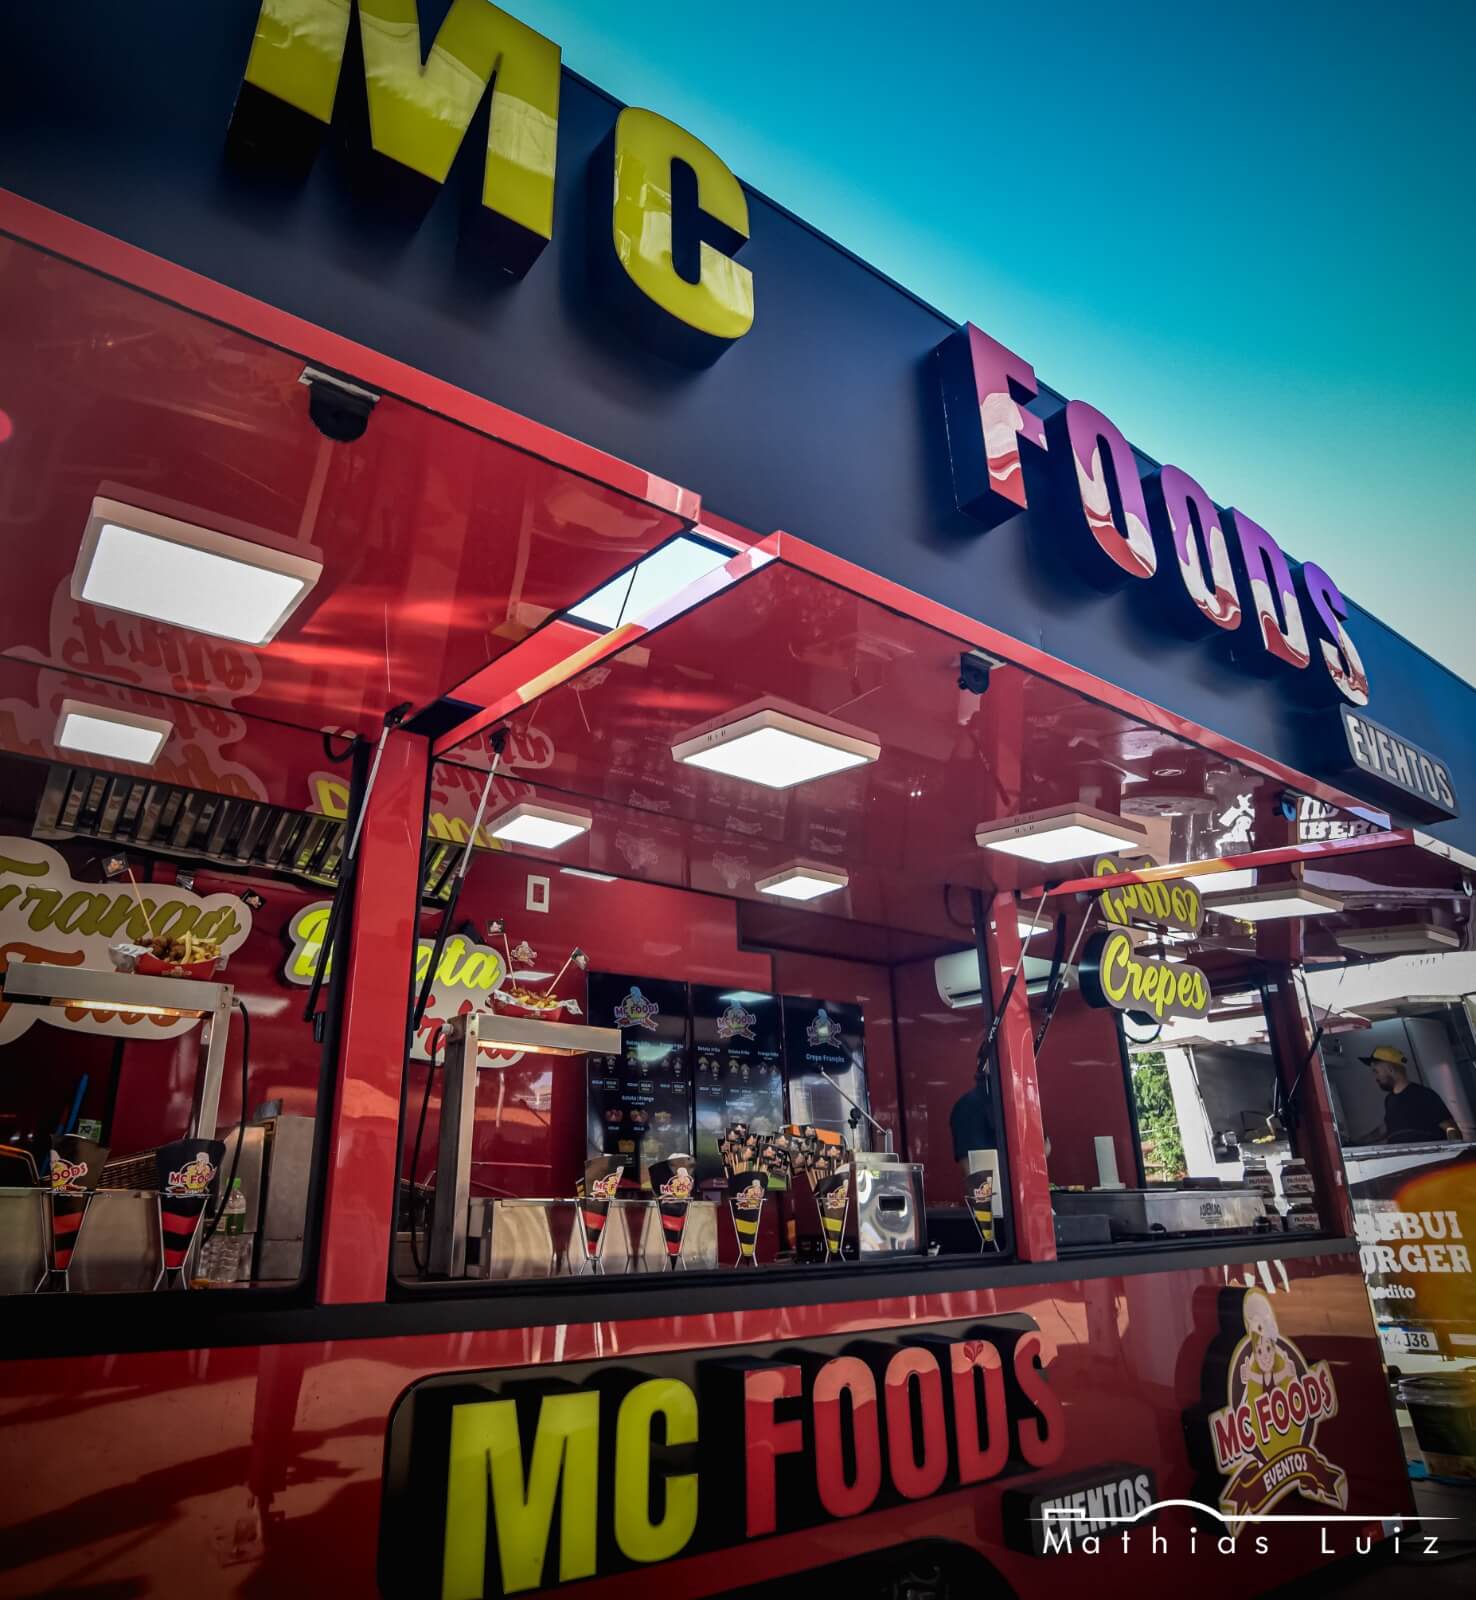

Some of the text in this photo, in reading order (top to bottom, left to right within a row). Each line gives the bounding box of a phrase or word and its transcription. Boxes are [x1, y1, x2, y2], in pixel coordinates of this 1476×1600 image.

[243, 0, 1369, 706] MC FOODS
[1346, 714, 1455, 807] EVENTOS
[1103, 934, 1208, 1018] Crepes
[52, 1163, 87, 1182] OODS
[1358, 1244, 1473, 1275] URGER
[1214, 1368, 1333, 1464] MC FOODS
[441, 1332, 1067, 1600] MC FOODS
[1262, 1453, 1309, 1492] EVENTOS
[1040, 1473, 1152, 1547] EVENTOS
